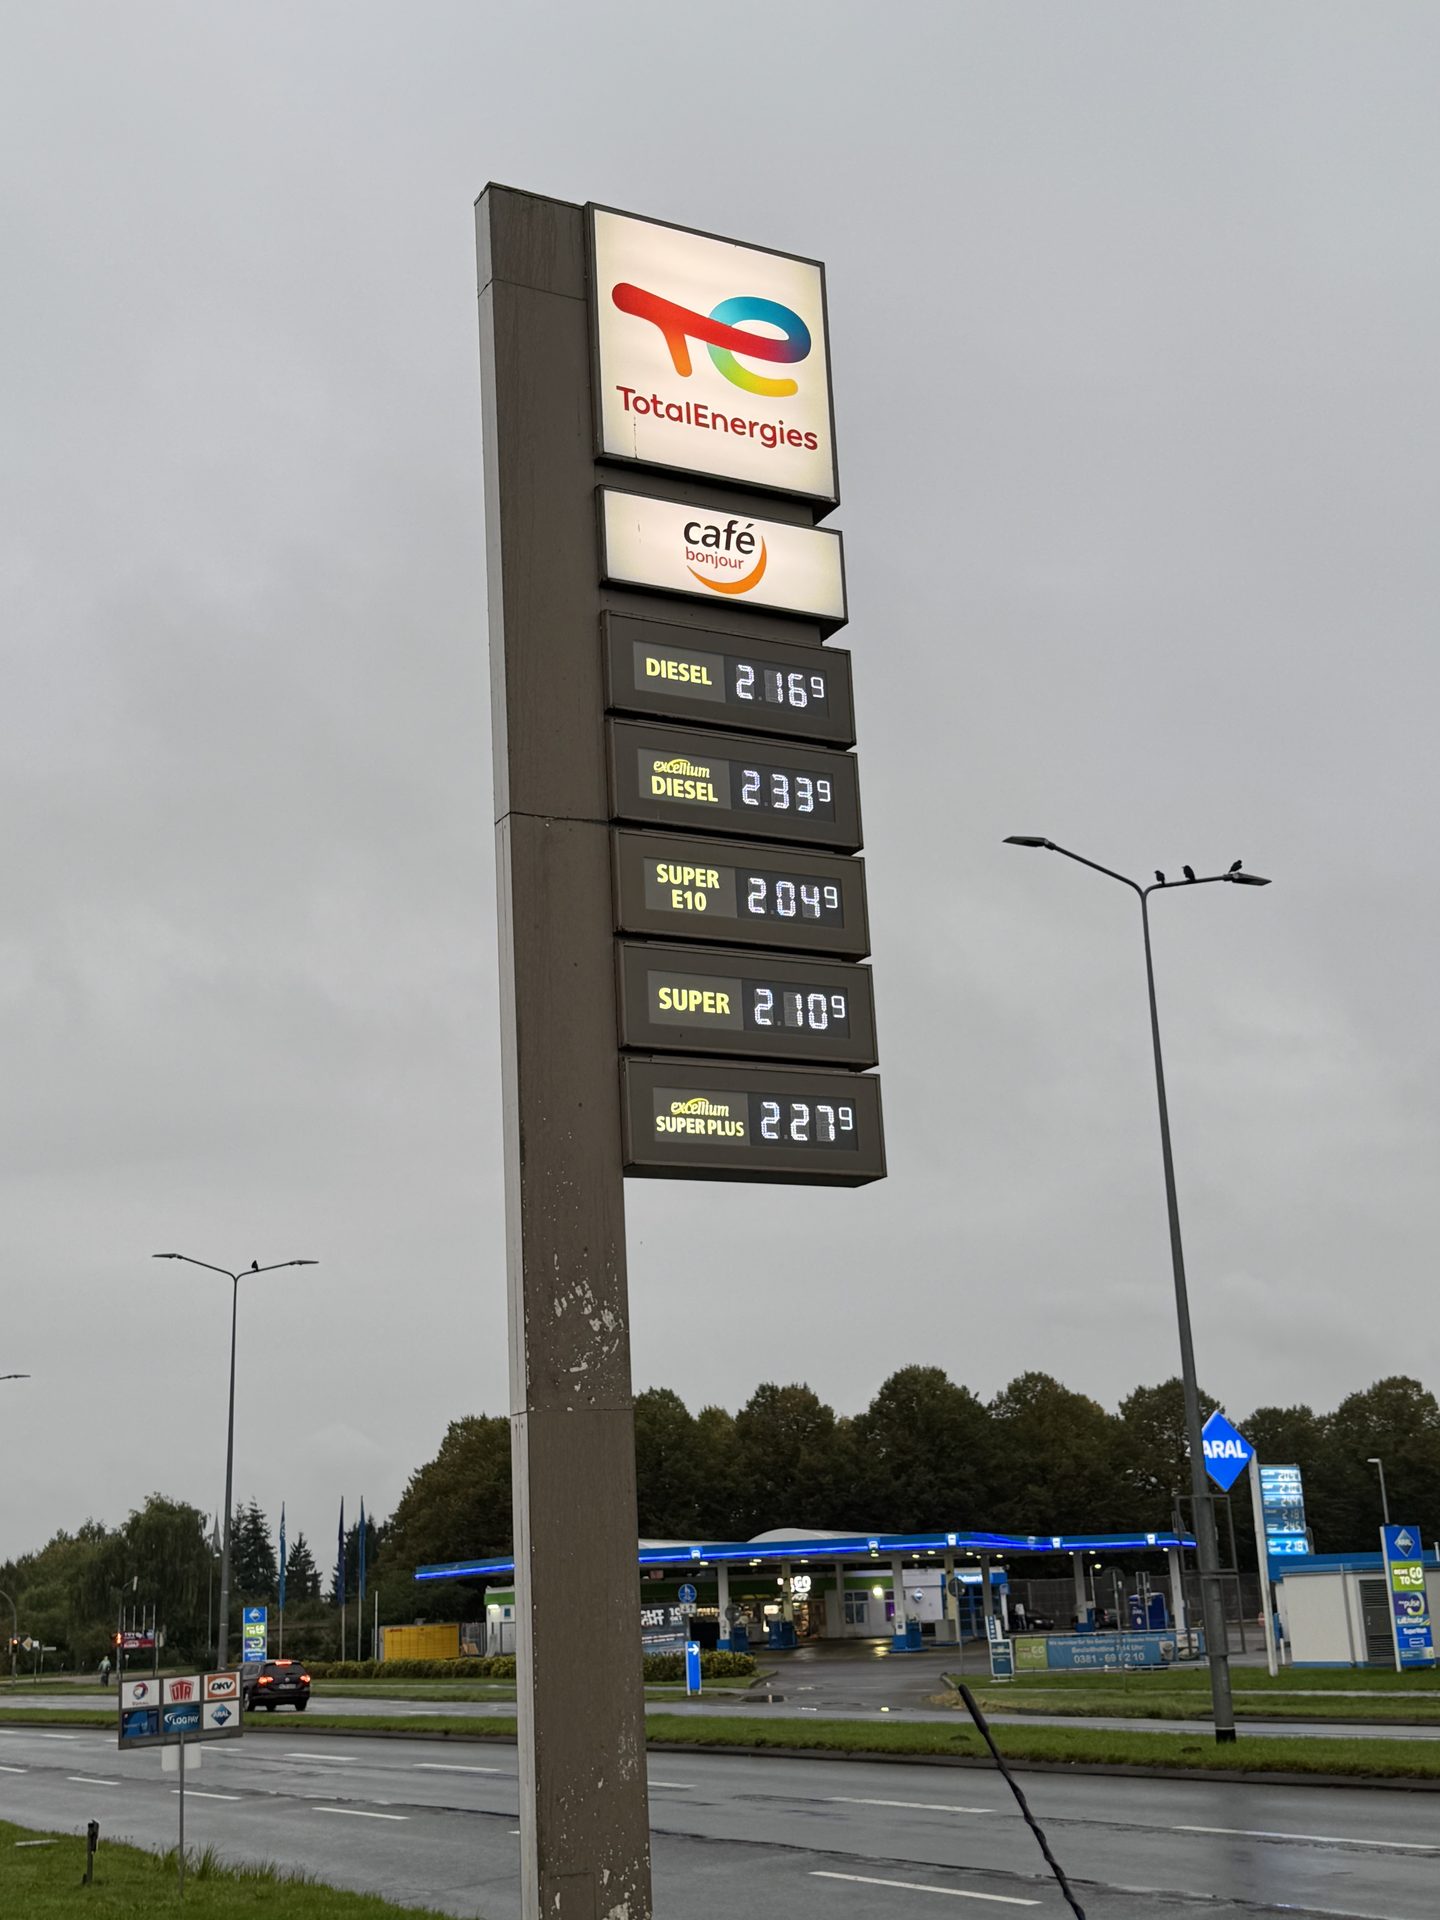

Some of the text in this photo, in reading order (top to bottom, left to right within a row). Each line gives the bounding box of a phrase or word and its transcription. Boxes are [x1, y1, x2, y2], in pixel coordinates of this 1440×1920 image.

[615, 385, 818, 451] TotalEnergies
[683, 519, 756, 554] café
[685, 545, 745, 570] bonjour
[645, 657, 712, 686] DIESEL
[653, 758, 711, 779] excellium
[651, 775, 719, 803] DIESEL
[656, 863, 720, 889] SUPER
[671, 889, 707, 912] E10
[658, 986, 731, 1014] SUPER
[655, 1116, 745, 1137] SUPER PLUS
[1203, 1439, 1248, 1459] ARAL
[1399, 1576, 1411, 1585] TO
[1409, 1567, 1423, 1578] GO
[211, 1681, 233, 1691] DKV
